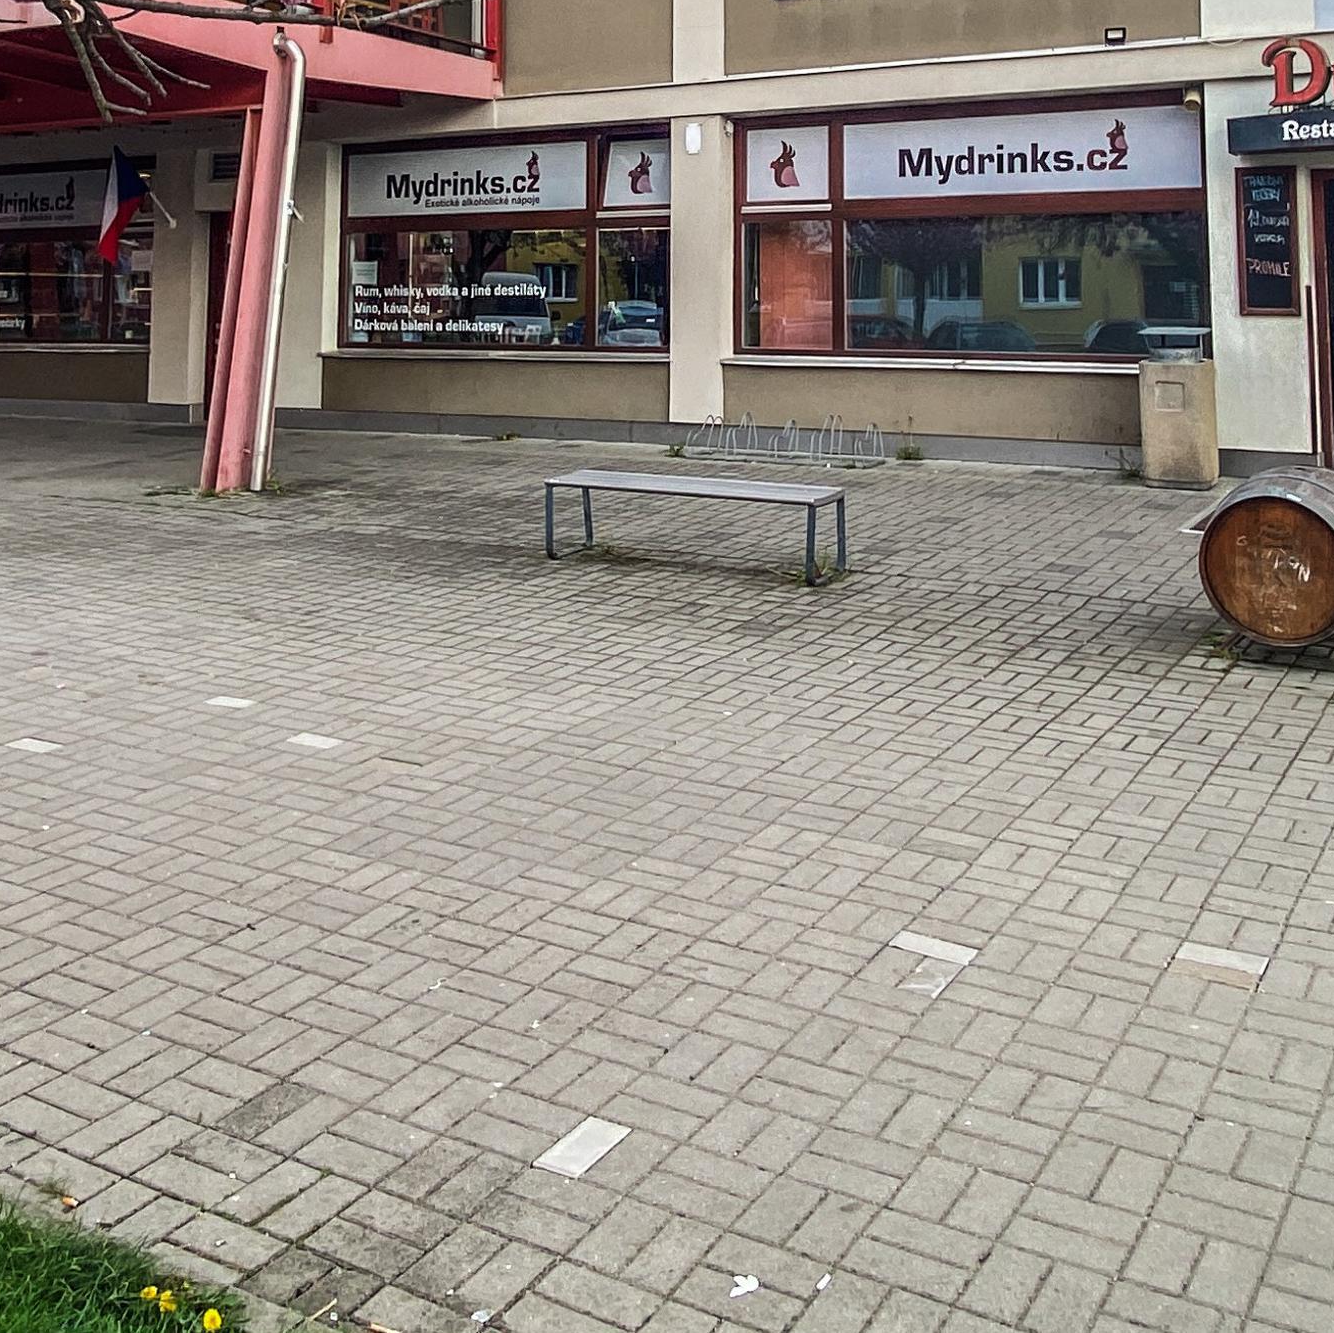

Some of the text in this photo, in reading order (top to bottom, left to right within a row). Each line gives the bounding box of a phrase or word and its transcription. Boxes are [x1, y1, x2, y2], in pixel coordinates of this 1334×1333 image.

[898, 142, 1128, 185] Mydrinks.cz
[386, 169, 540, 205] Mydrinks.cz
[425, 198, 460, 208] Exotické
[511, 195, 540, 207] nápoje
[355, 283, 547, 299] Rum, whisky, vodka a jiné destiláty
[413, 302, 430, 315] čaj
[354, 319, 399, 332] Dárková
[445, 319, 504, 334] delikatesy
